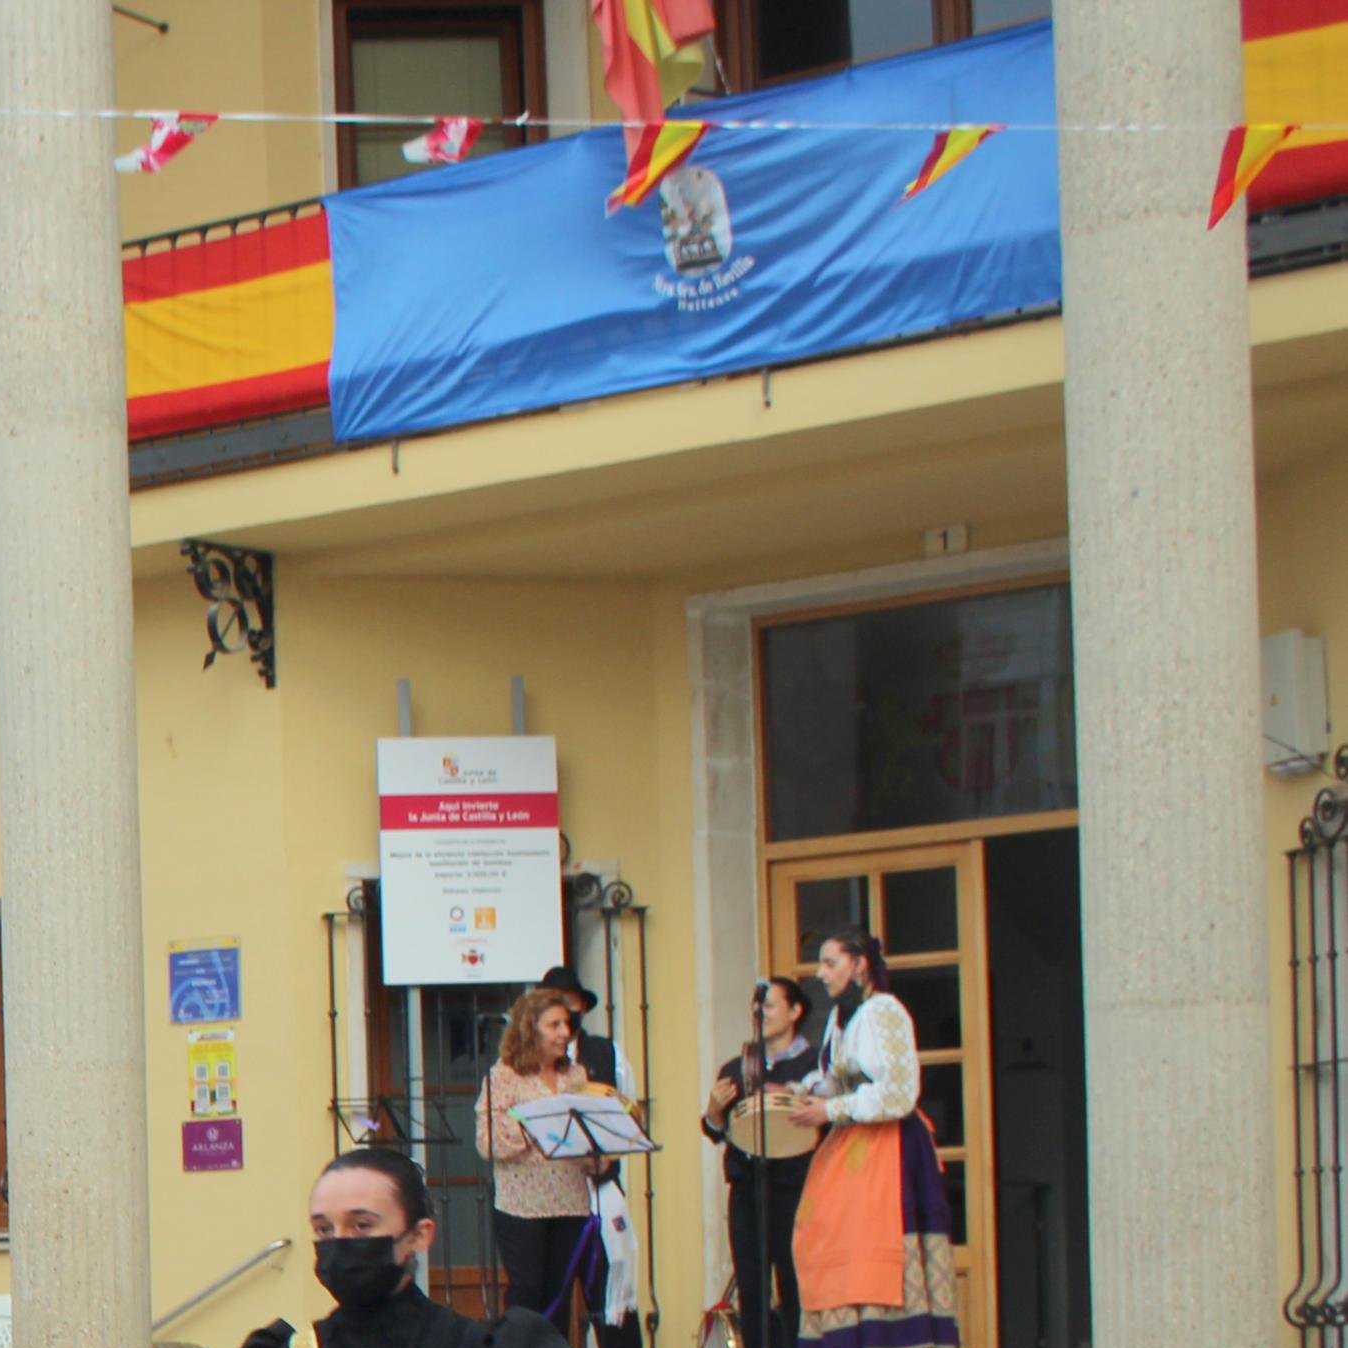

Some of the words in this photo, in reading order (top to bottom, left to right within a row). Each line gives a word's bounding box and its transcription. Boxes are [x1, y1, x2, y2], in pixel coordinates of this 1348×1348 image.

[408, 811, 418, 823] la
[420, 811, 447, 823] Junta
[448, 811, 460, 823] de
[462, 810, 497, 823] Castilla
[506, 809, 530, 822] León
